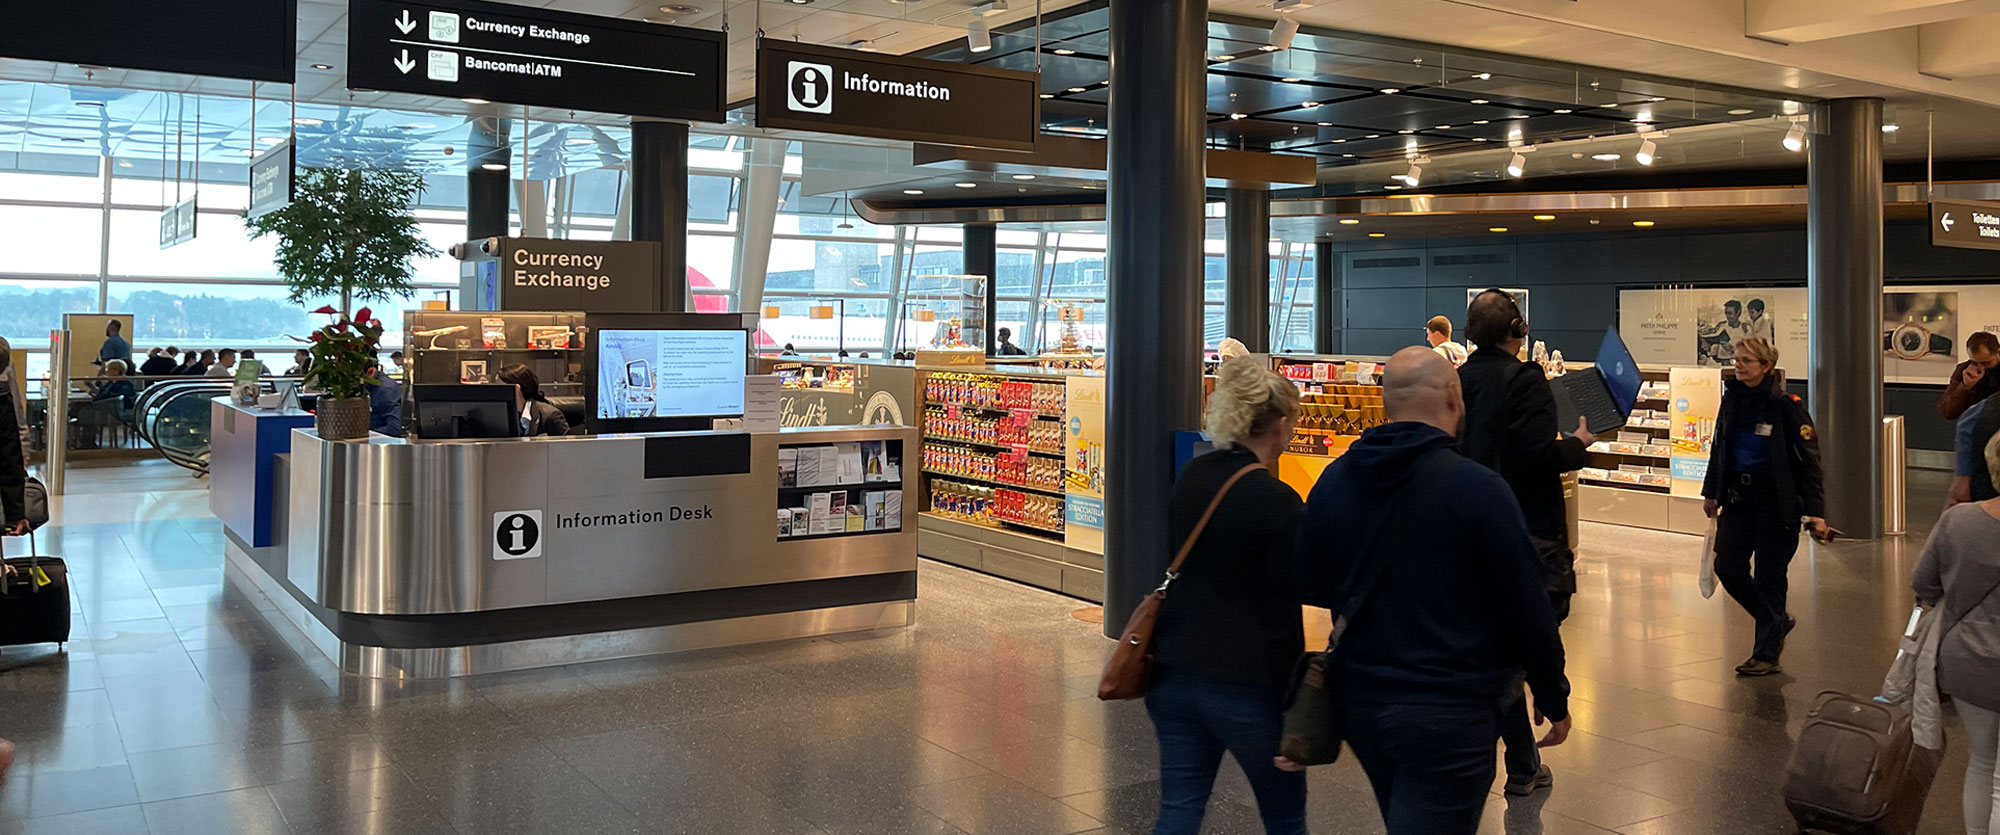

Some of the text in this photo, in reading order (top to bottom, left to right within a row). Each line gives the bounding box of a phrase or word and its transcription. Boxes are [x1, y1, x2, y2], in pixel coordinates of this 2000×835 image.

[466, 17, 590, 44] Currency Exchange
[844, 71, 950, 101] Information
[1972, 212, 2000, 225] Toiletten
[1979, 225, 2000, 238] Toilets
[513, 249, 604, 270] Currency
[514, 270, 611, 290] Exchange
[1289, 445, 1314, 453] NUXOR
[556, 504, 713, 529] Information Desk
[1075, 512, 1097, 524] EDITION
